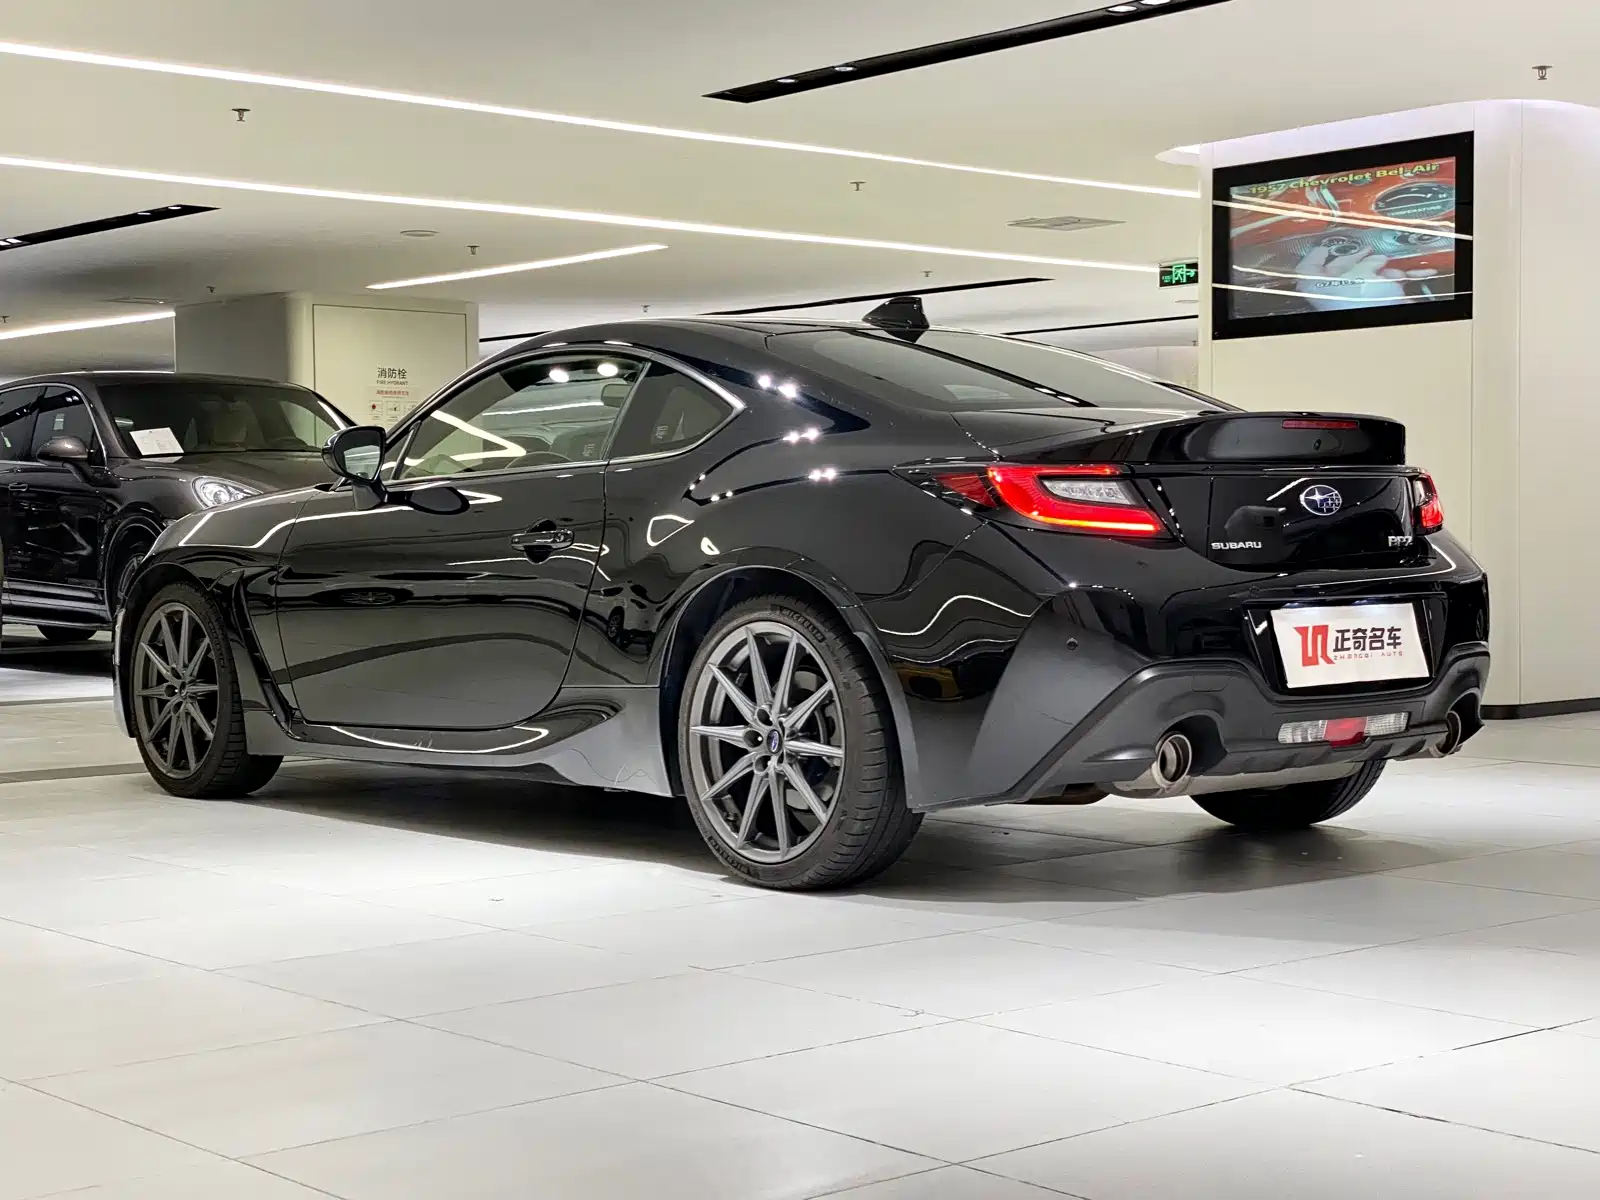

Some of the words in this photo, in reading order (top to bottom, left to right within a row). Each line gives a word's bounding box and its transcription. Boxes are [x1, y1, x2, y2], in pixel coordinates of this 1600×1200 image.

[1289, 172, 1372, 190] Chevrolet
[378, 367, 407, 379] 消防栓
[1210, 541, 1262, 550] SUBARU
[780, 606, 825, 642] MICHELIN
[1332, 626, 1402, 652] 正奇名车
